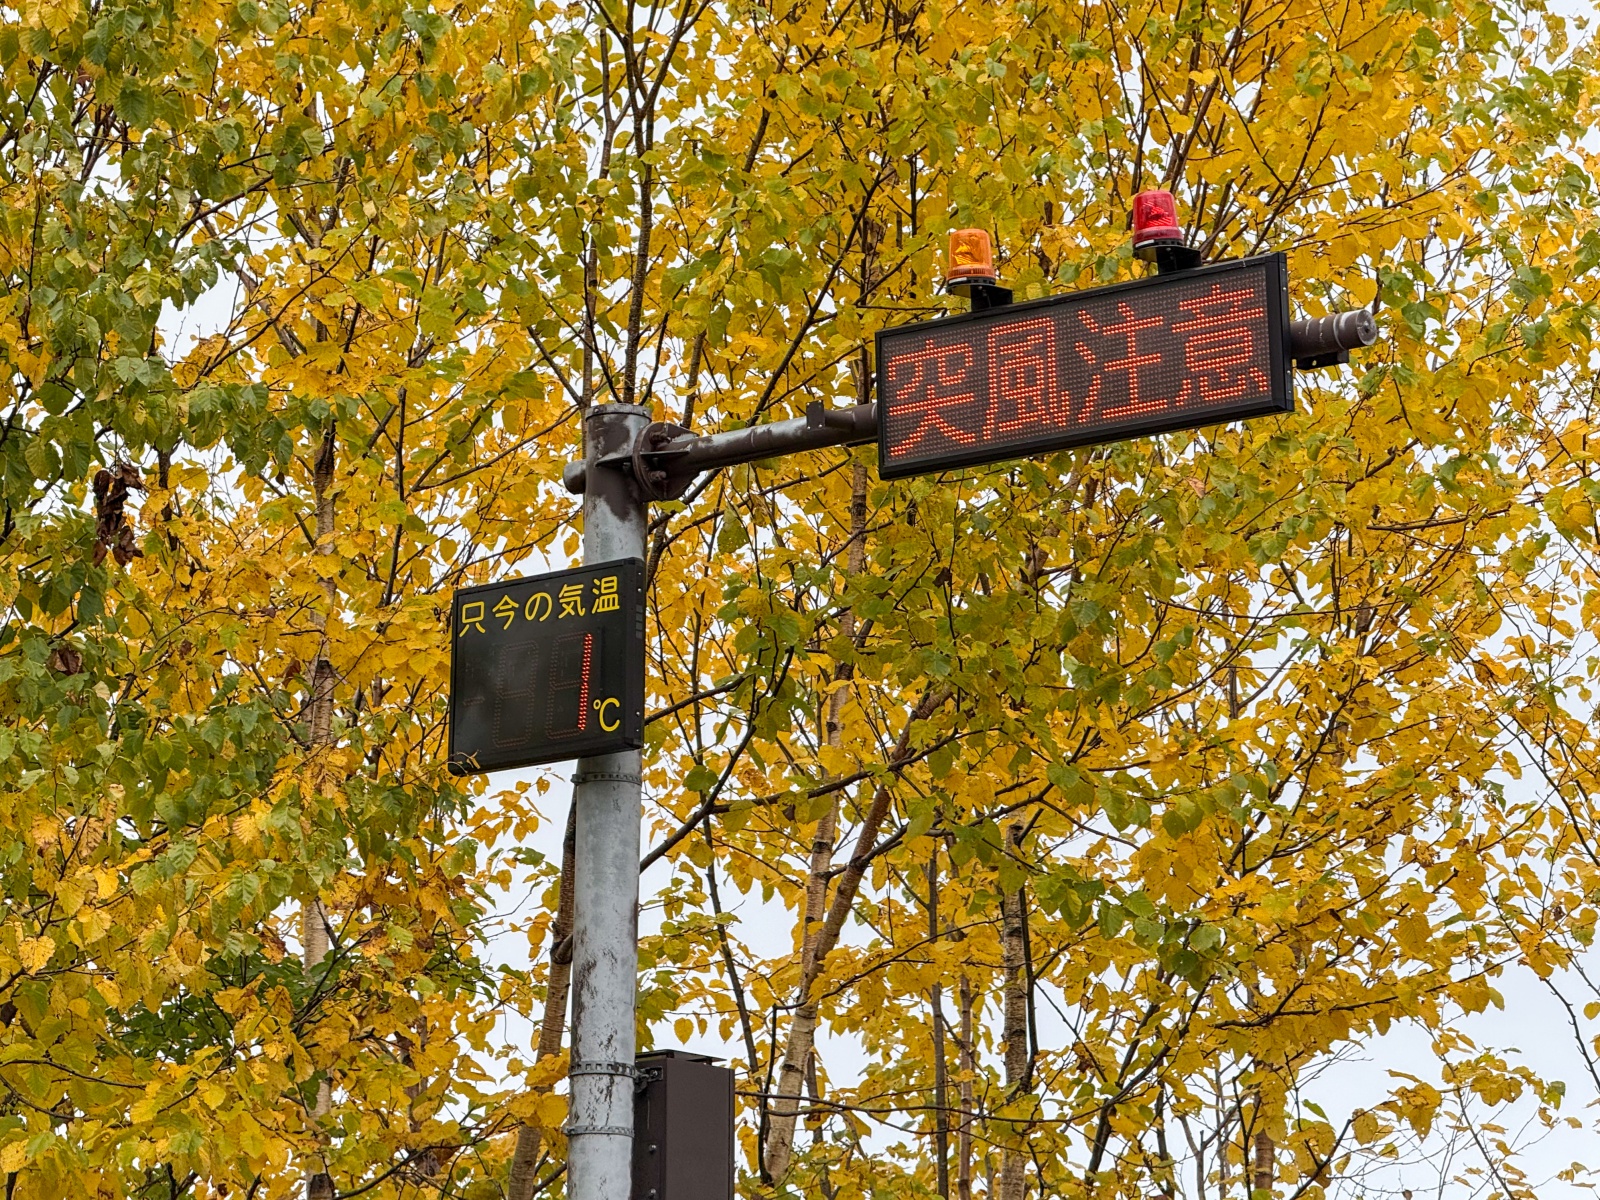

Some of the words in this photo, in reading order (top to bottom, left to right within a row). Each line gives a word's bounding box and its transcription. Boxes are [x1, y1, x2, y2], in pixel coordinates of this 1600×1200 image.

[886, 284, 1269, 457] 突風注意
[459, 575, 620, 637] 只今の気温
